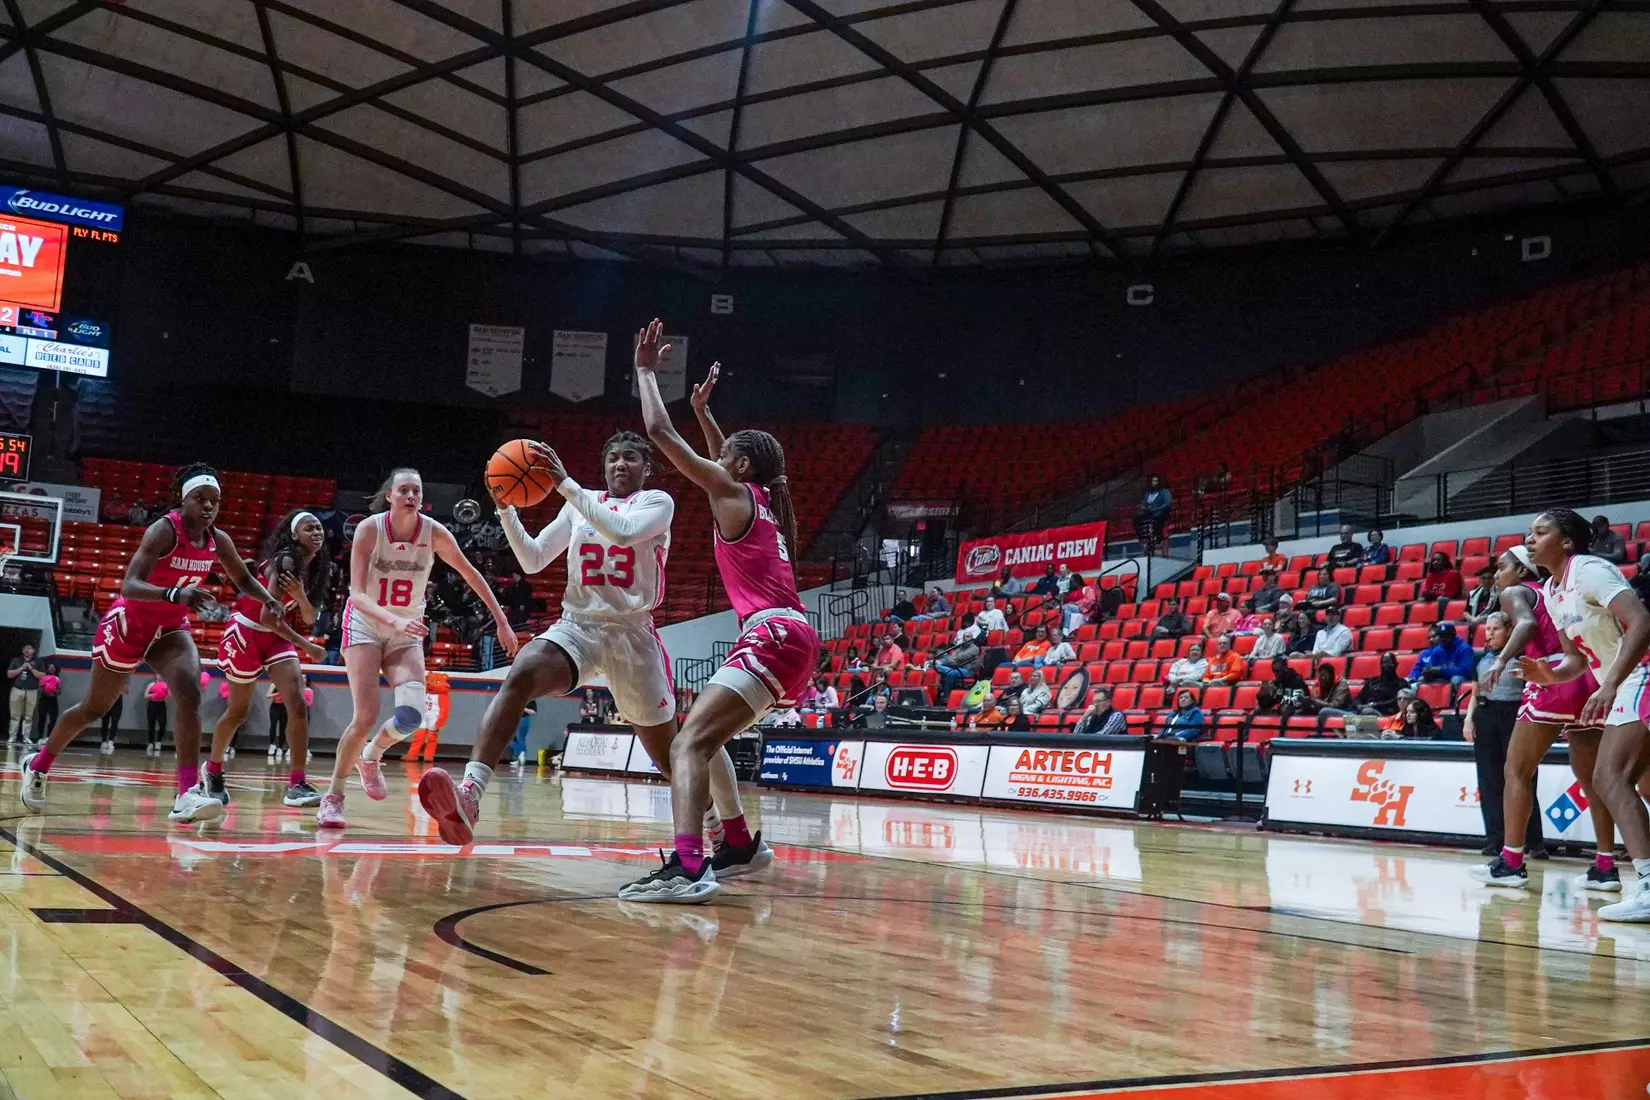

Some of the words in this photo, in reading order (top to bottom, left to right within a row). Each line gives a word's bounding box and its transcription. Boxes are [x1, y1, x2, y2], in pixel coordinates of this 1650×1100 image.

[74, 227, 88, 237] PLY
[91, 230, 100, 240] FL
[102, 232, 118, 242] PTS
[1522, 236, 1551, 261] D
[285, 261, 314, 284] A
[1127, 284, 1154, 305] C
[711, 294, 733, 314] B
[2, 307, 13, 322] 2
[35, 352, 66, 363] USED
[70, 356, 100, 368] CARS
[1004, 543, 1054, 566] CANIAC
[1057, 537, 1099, 559] CREW
[170, 556, 188, 570] SAM
[579, 543, 635, 588] 23
[377, 578, 413, 607] 18
[765, 745, 775, 753] The
[775, 745, 793, 754] Official
[793, 746, 813, 755] Internet
[763, 756, 783, 765] provider
[1015, 749, 1112, 774] ARTECH
[1010, 773, 1036, 782] SIGNS
[1037, 774, 1045, 783] &
[1045, 775, 1091, 786] LIGHTING,
[1092, 778, 1111, 787] INC.
[1017, 787, 1098, 802] 936.435.9966
